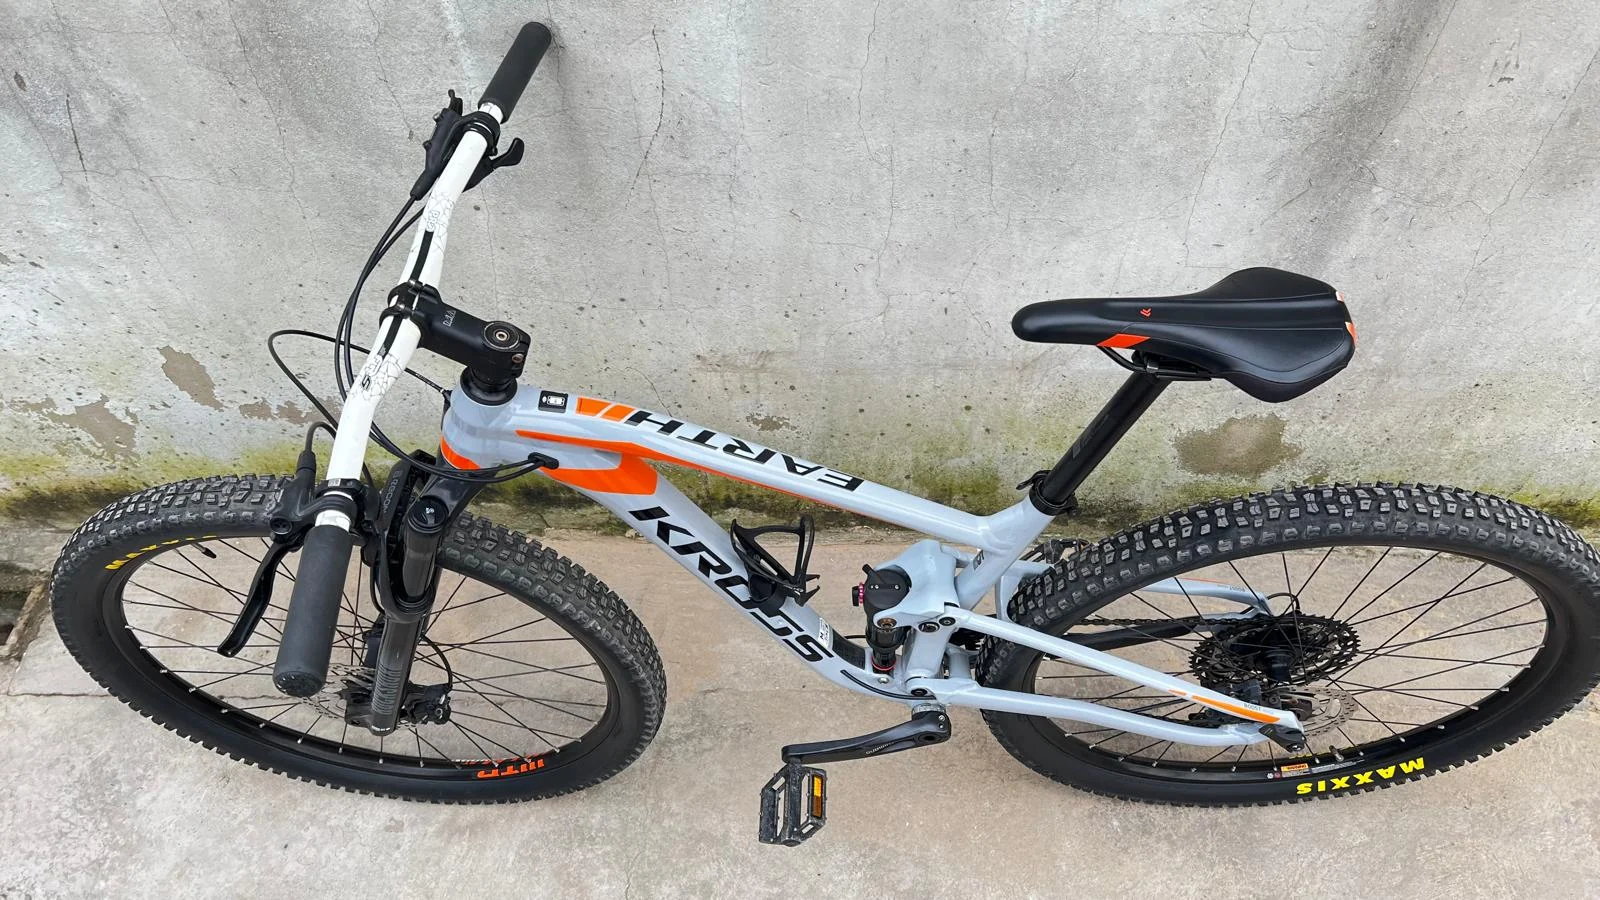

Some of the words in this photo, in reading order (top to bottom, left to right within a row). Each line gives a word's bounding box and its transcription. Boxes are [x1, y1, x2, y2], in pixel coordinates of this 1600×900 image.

[625, 409, 866, 493] EARTH
[628, 505, 835, 664] KROSS
[1296, 757, 1425, 795] MAXXIS
